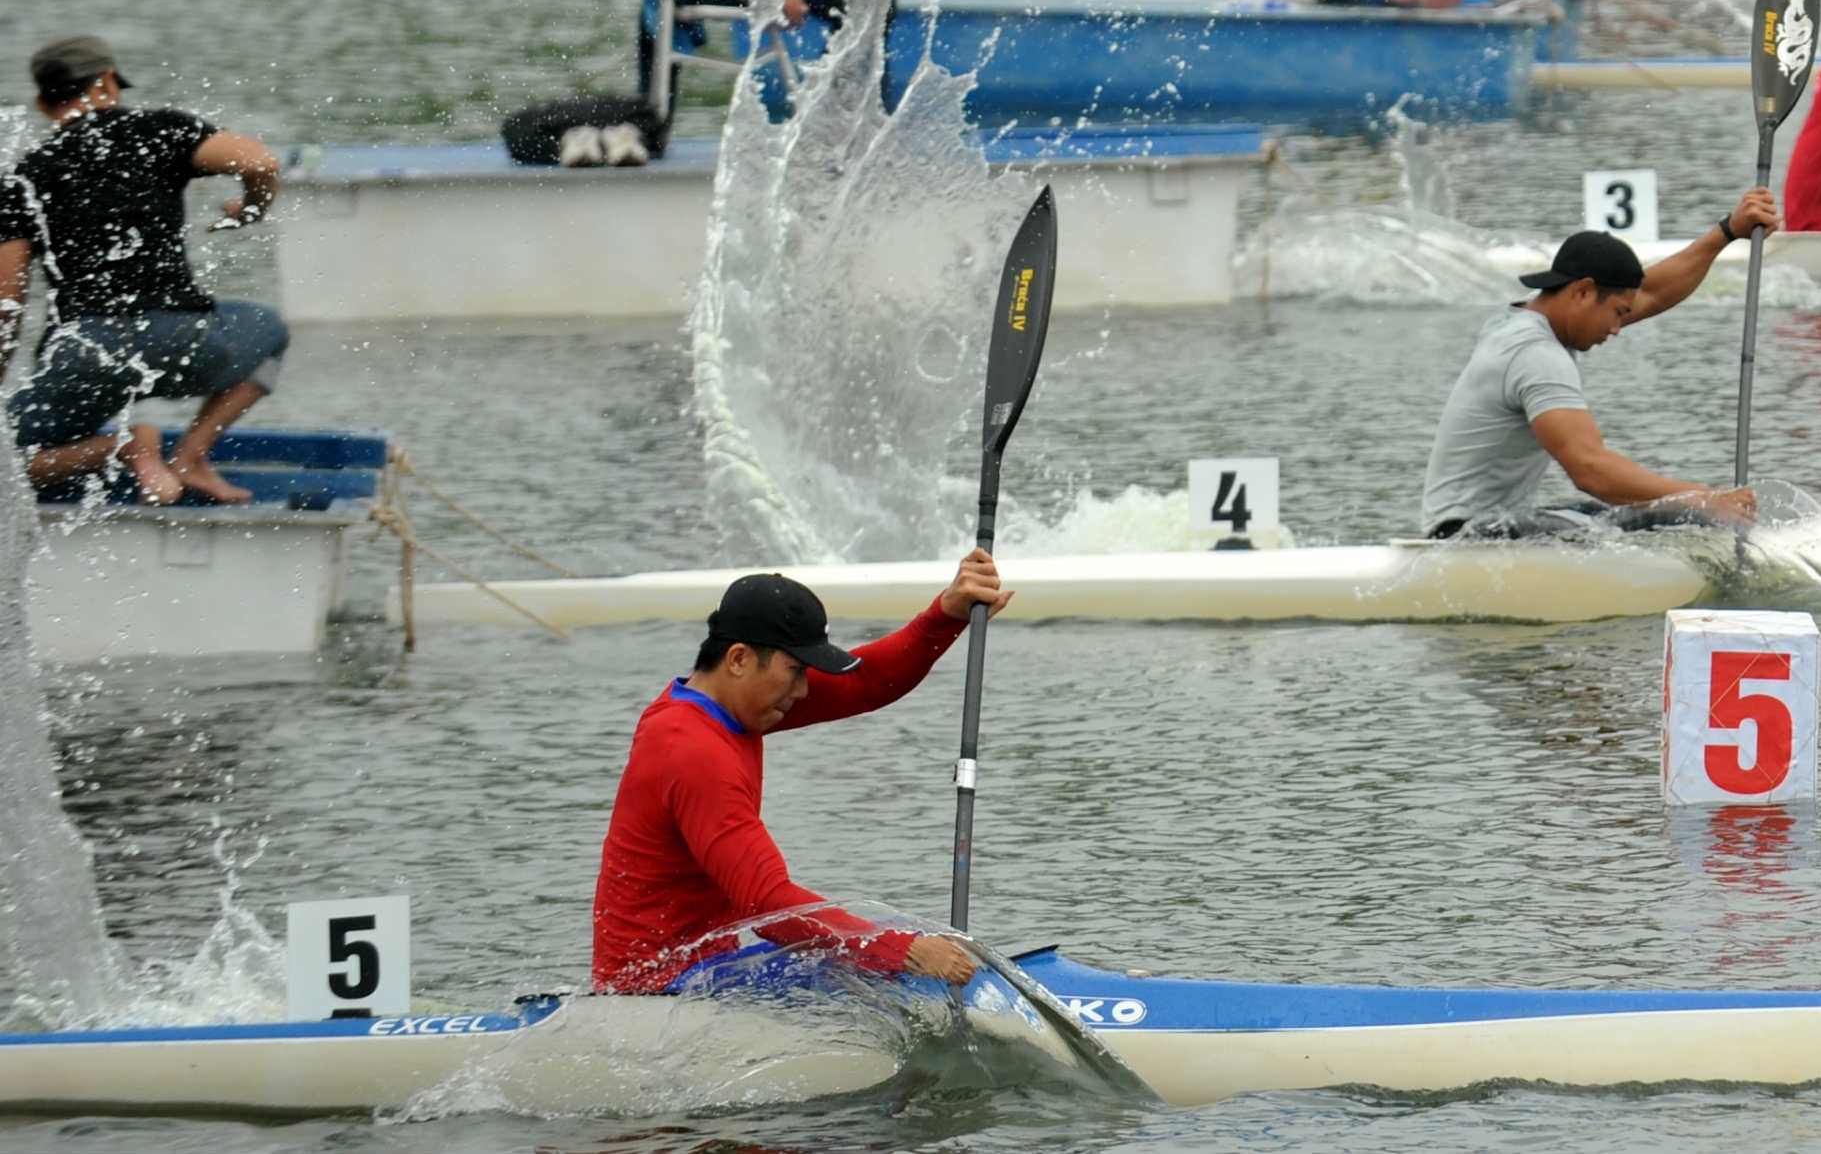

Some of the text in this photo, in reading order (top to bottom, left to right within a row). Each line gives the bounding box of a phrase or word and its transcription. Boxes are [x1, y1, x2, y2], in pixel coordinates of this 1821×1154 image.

[1605, 180, 1635, 230] 3
[1012, 314, 1027, 331] IV
[1211, 471, 1252, 533] 4
[1704, 651, 1793, 795] 5
[328, 914, 380, 1000] 5
[368, 1015, 487, 1035] EXCEL
[1066, 999, 1144, 1023] KO
